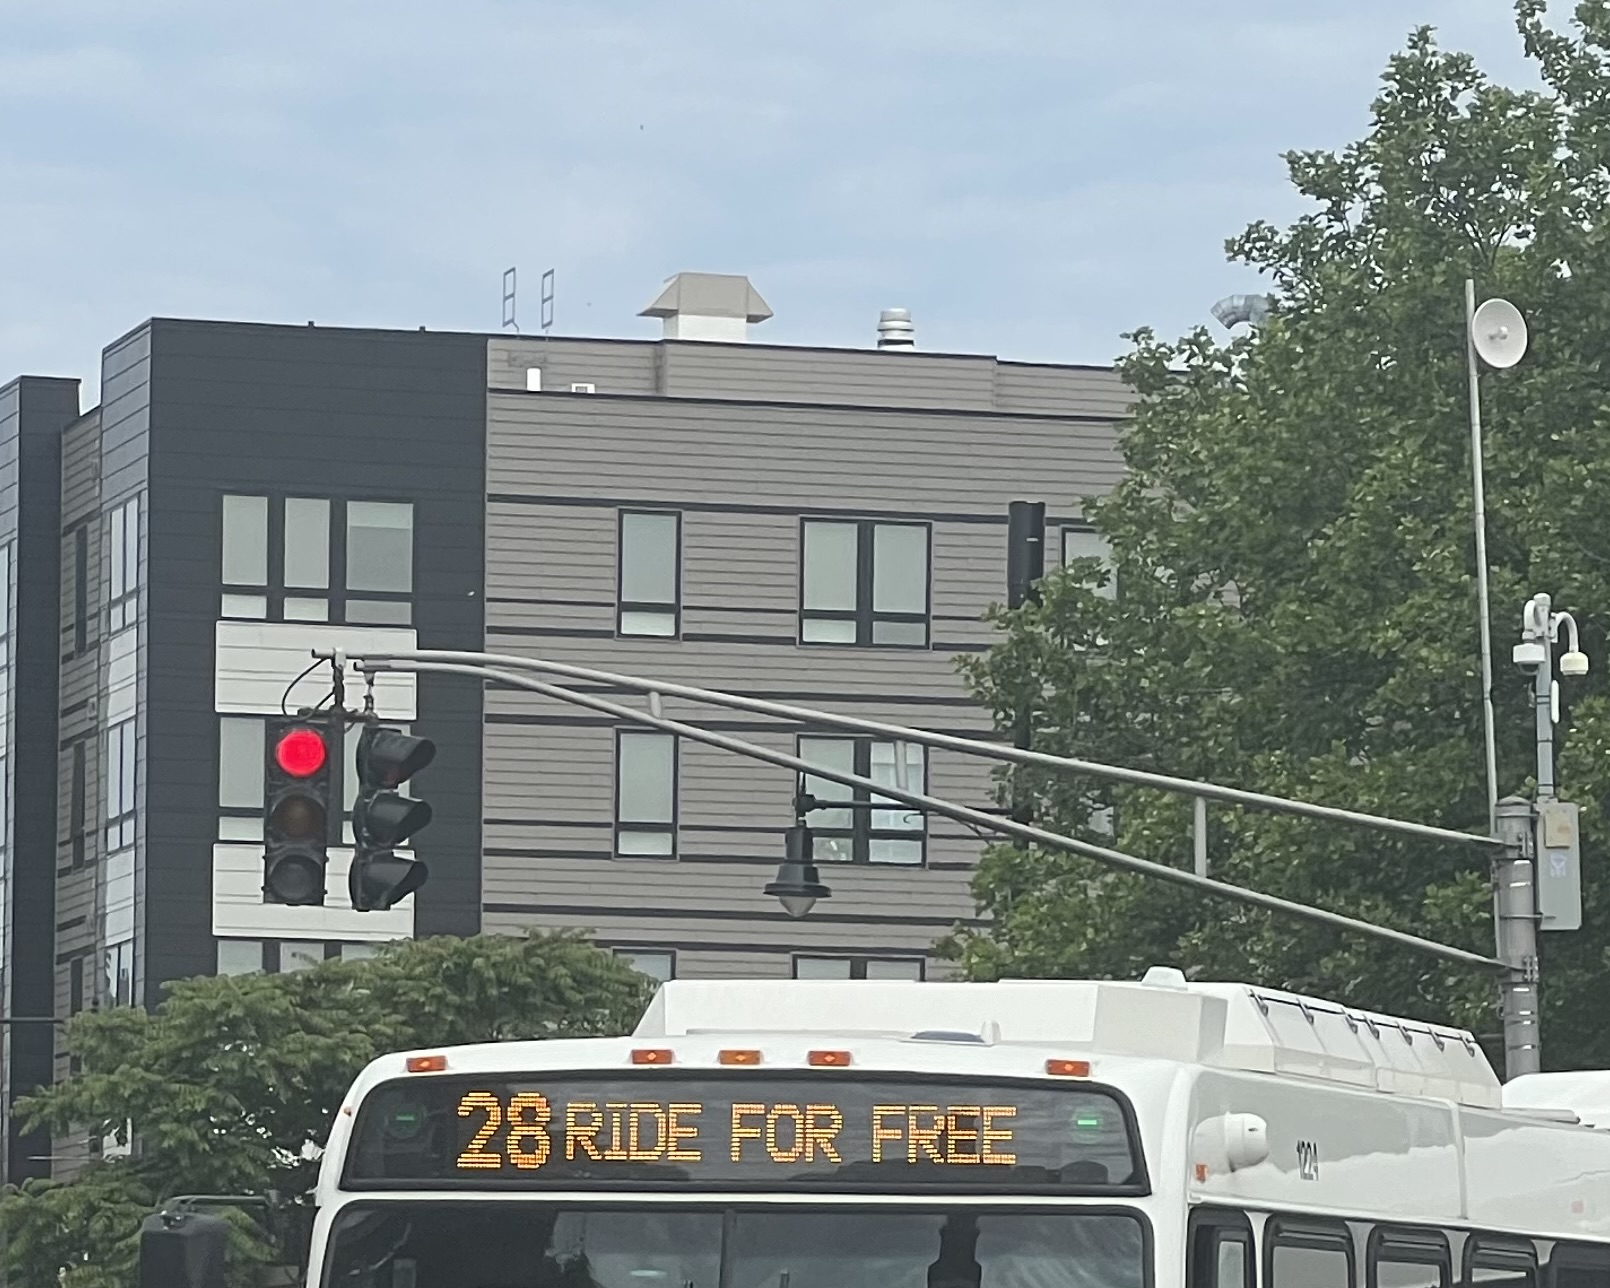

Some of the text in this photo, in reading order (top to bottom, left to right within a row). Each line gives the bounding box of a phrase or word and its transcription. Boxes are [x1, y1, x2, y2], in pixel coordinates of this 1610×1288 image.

[457, 1092, 1017, 1169] 28 RIDE FOR FREE
